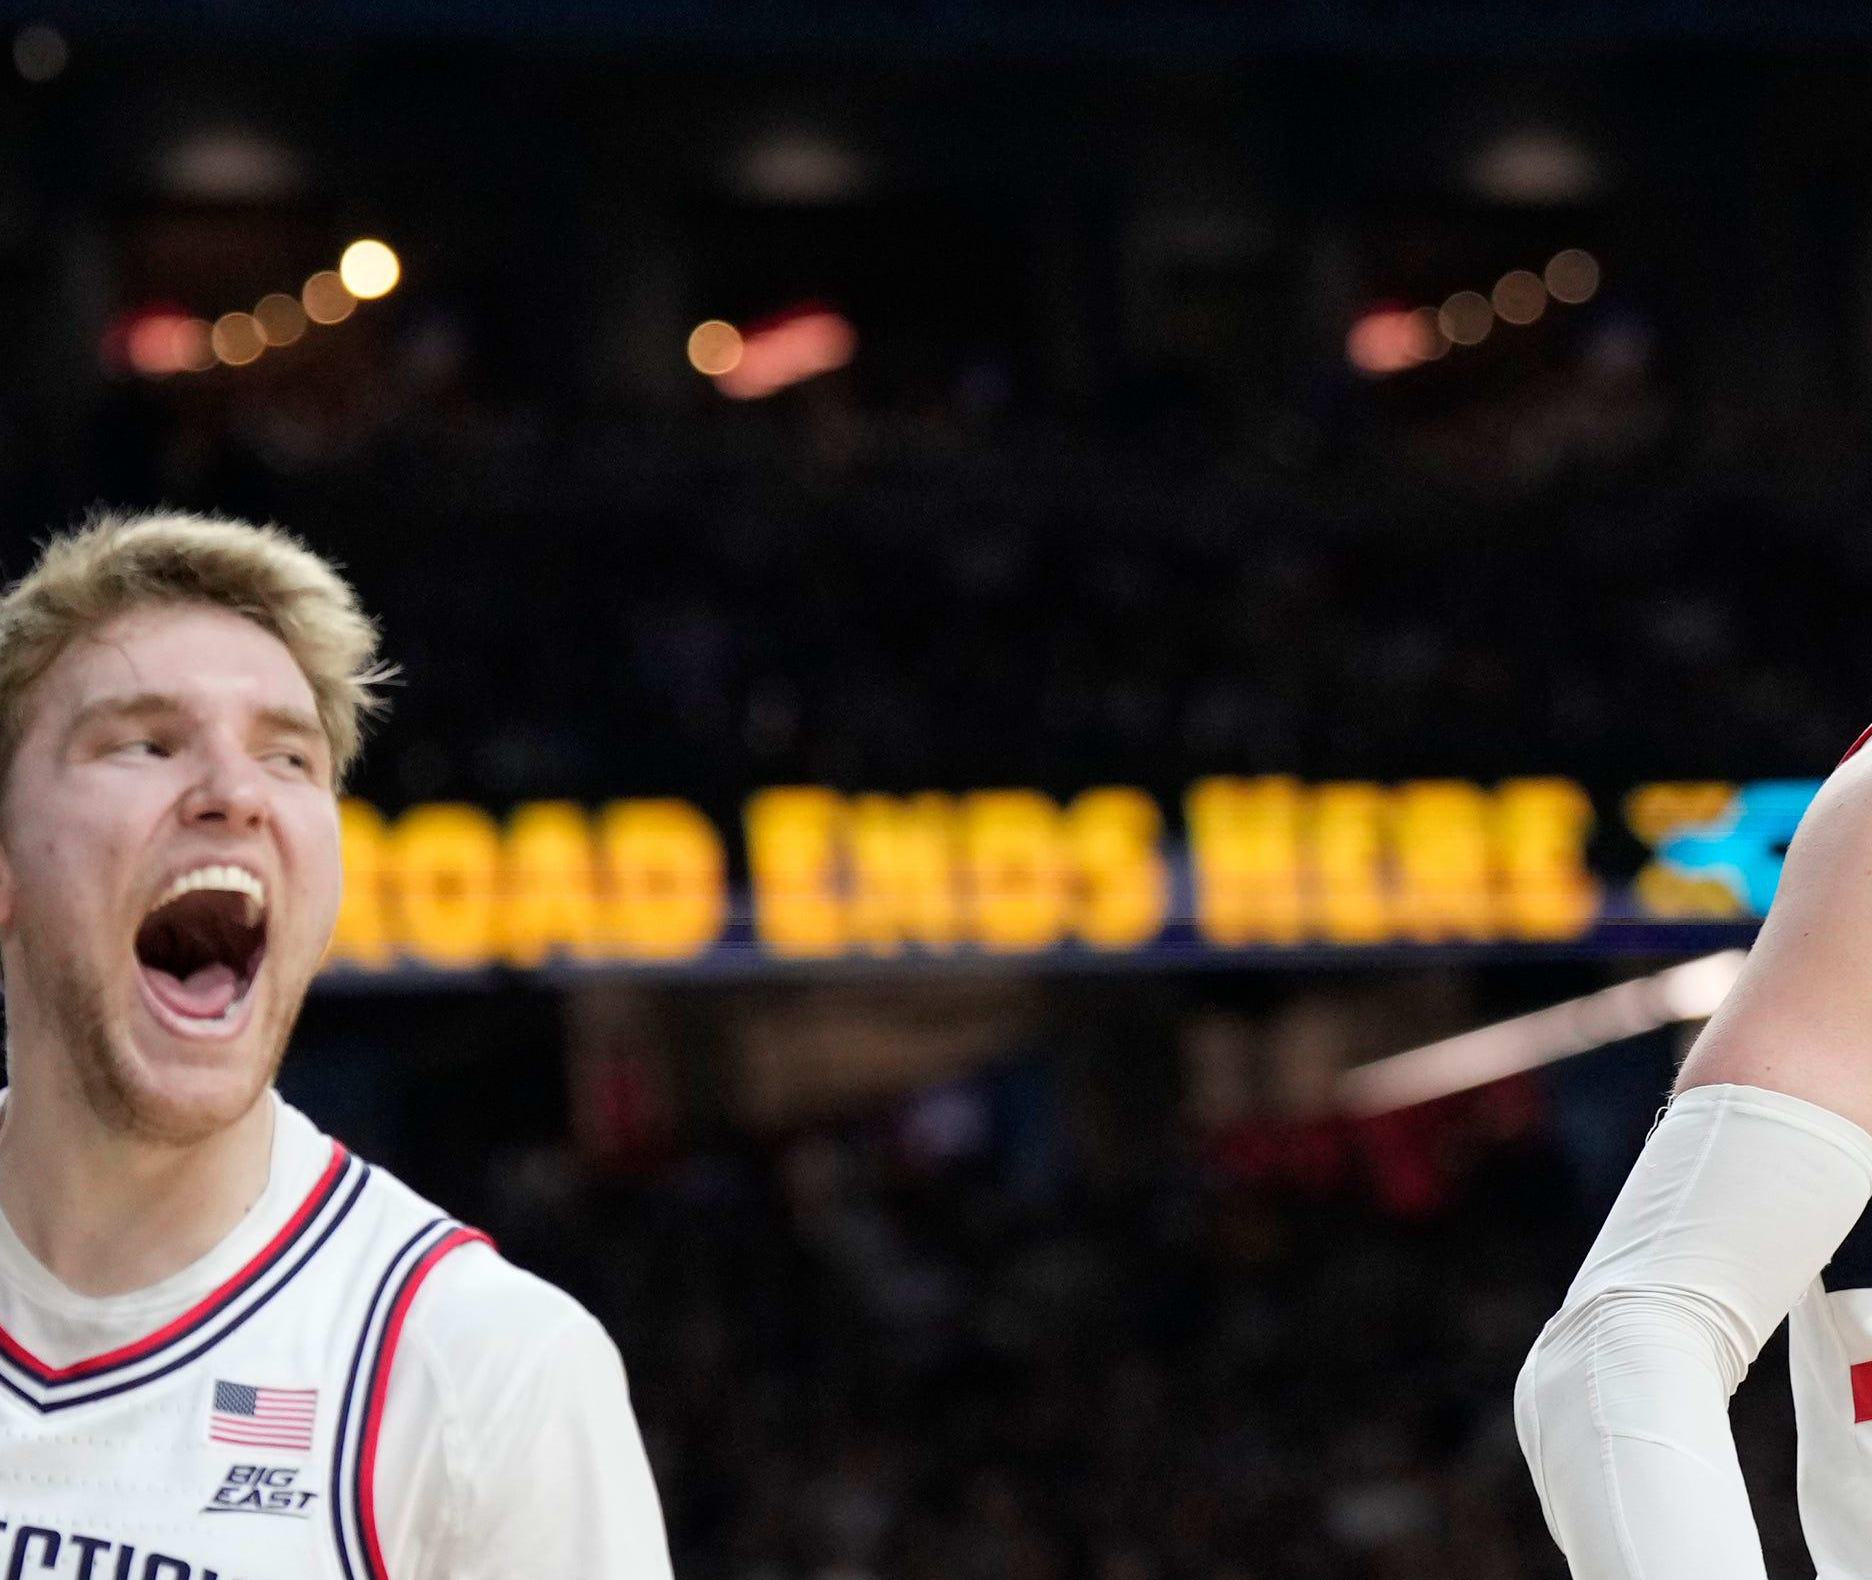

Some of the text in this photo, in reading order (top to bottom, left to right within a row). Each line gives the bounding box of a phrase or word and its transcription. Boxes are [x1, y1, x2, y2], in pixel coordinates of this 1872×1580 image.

[741, 784, 1168, 957] ENDS
[1186, 774, 1600, 946] HERE
[226, 1465, 299, 1487] BIG
[213, 1486, 318, 1508] EAST
